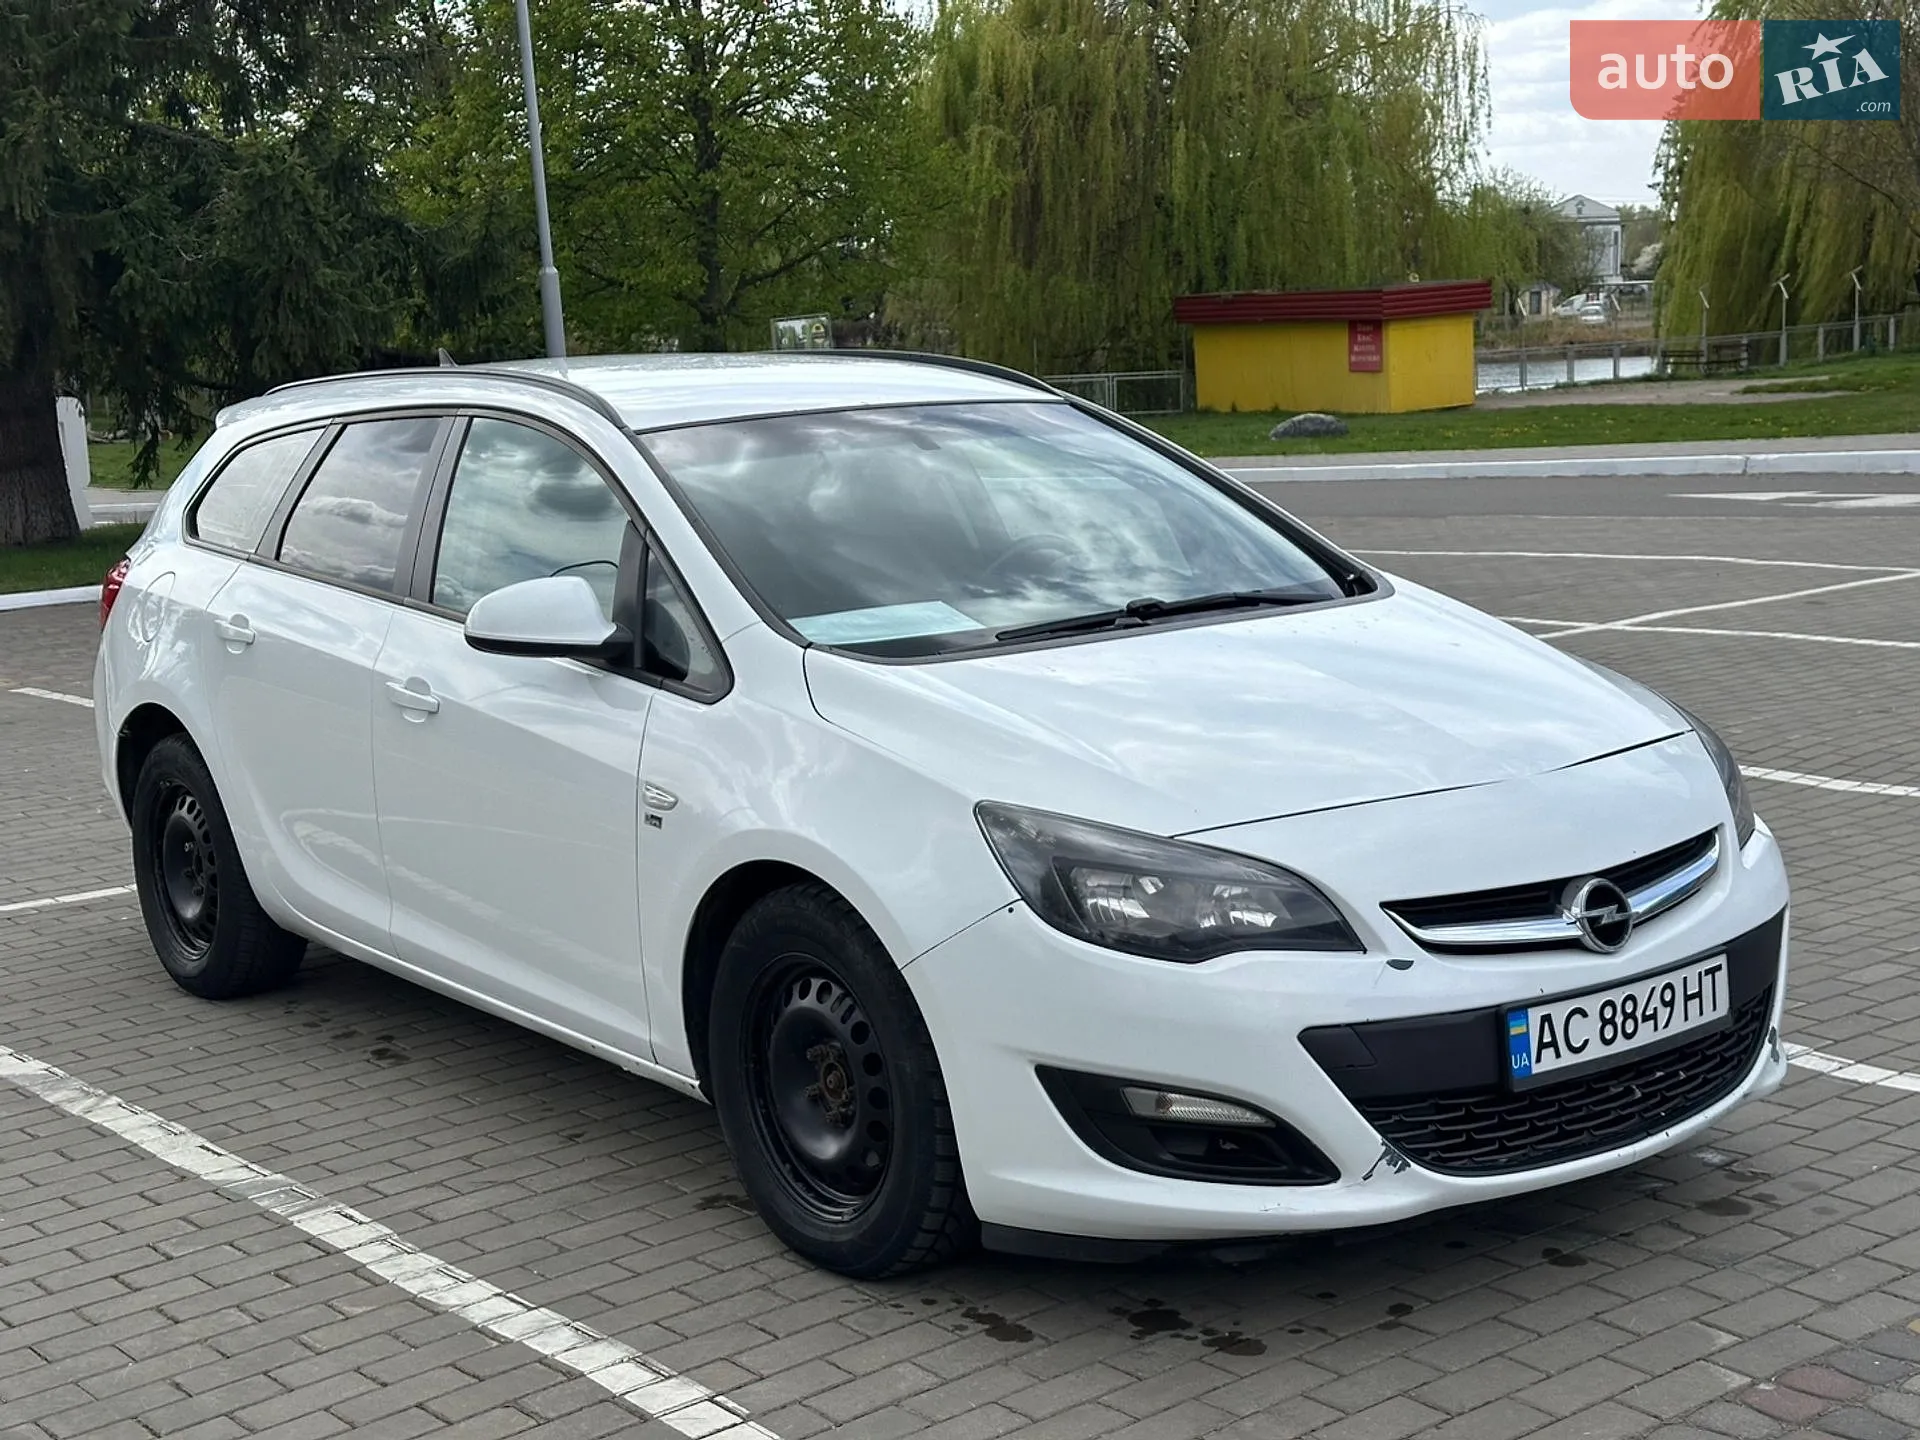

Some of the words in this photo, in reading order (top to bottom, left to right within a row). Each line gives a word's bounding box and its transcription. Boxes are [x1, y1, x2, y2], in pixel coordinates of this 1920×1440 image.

[1535, 1006, 1590, 1064] AC
[1599, 981, 1676, 1046] 8849
[1683, 963, 1723, 1022] HT
[1511, 1052, 1530, 1070] UA
